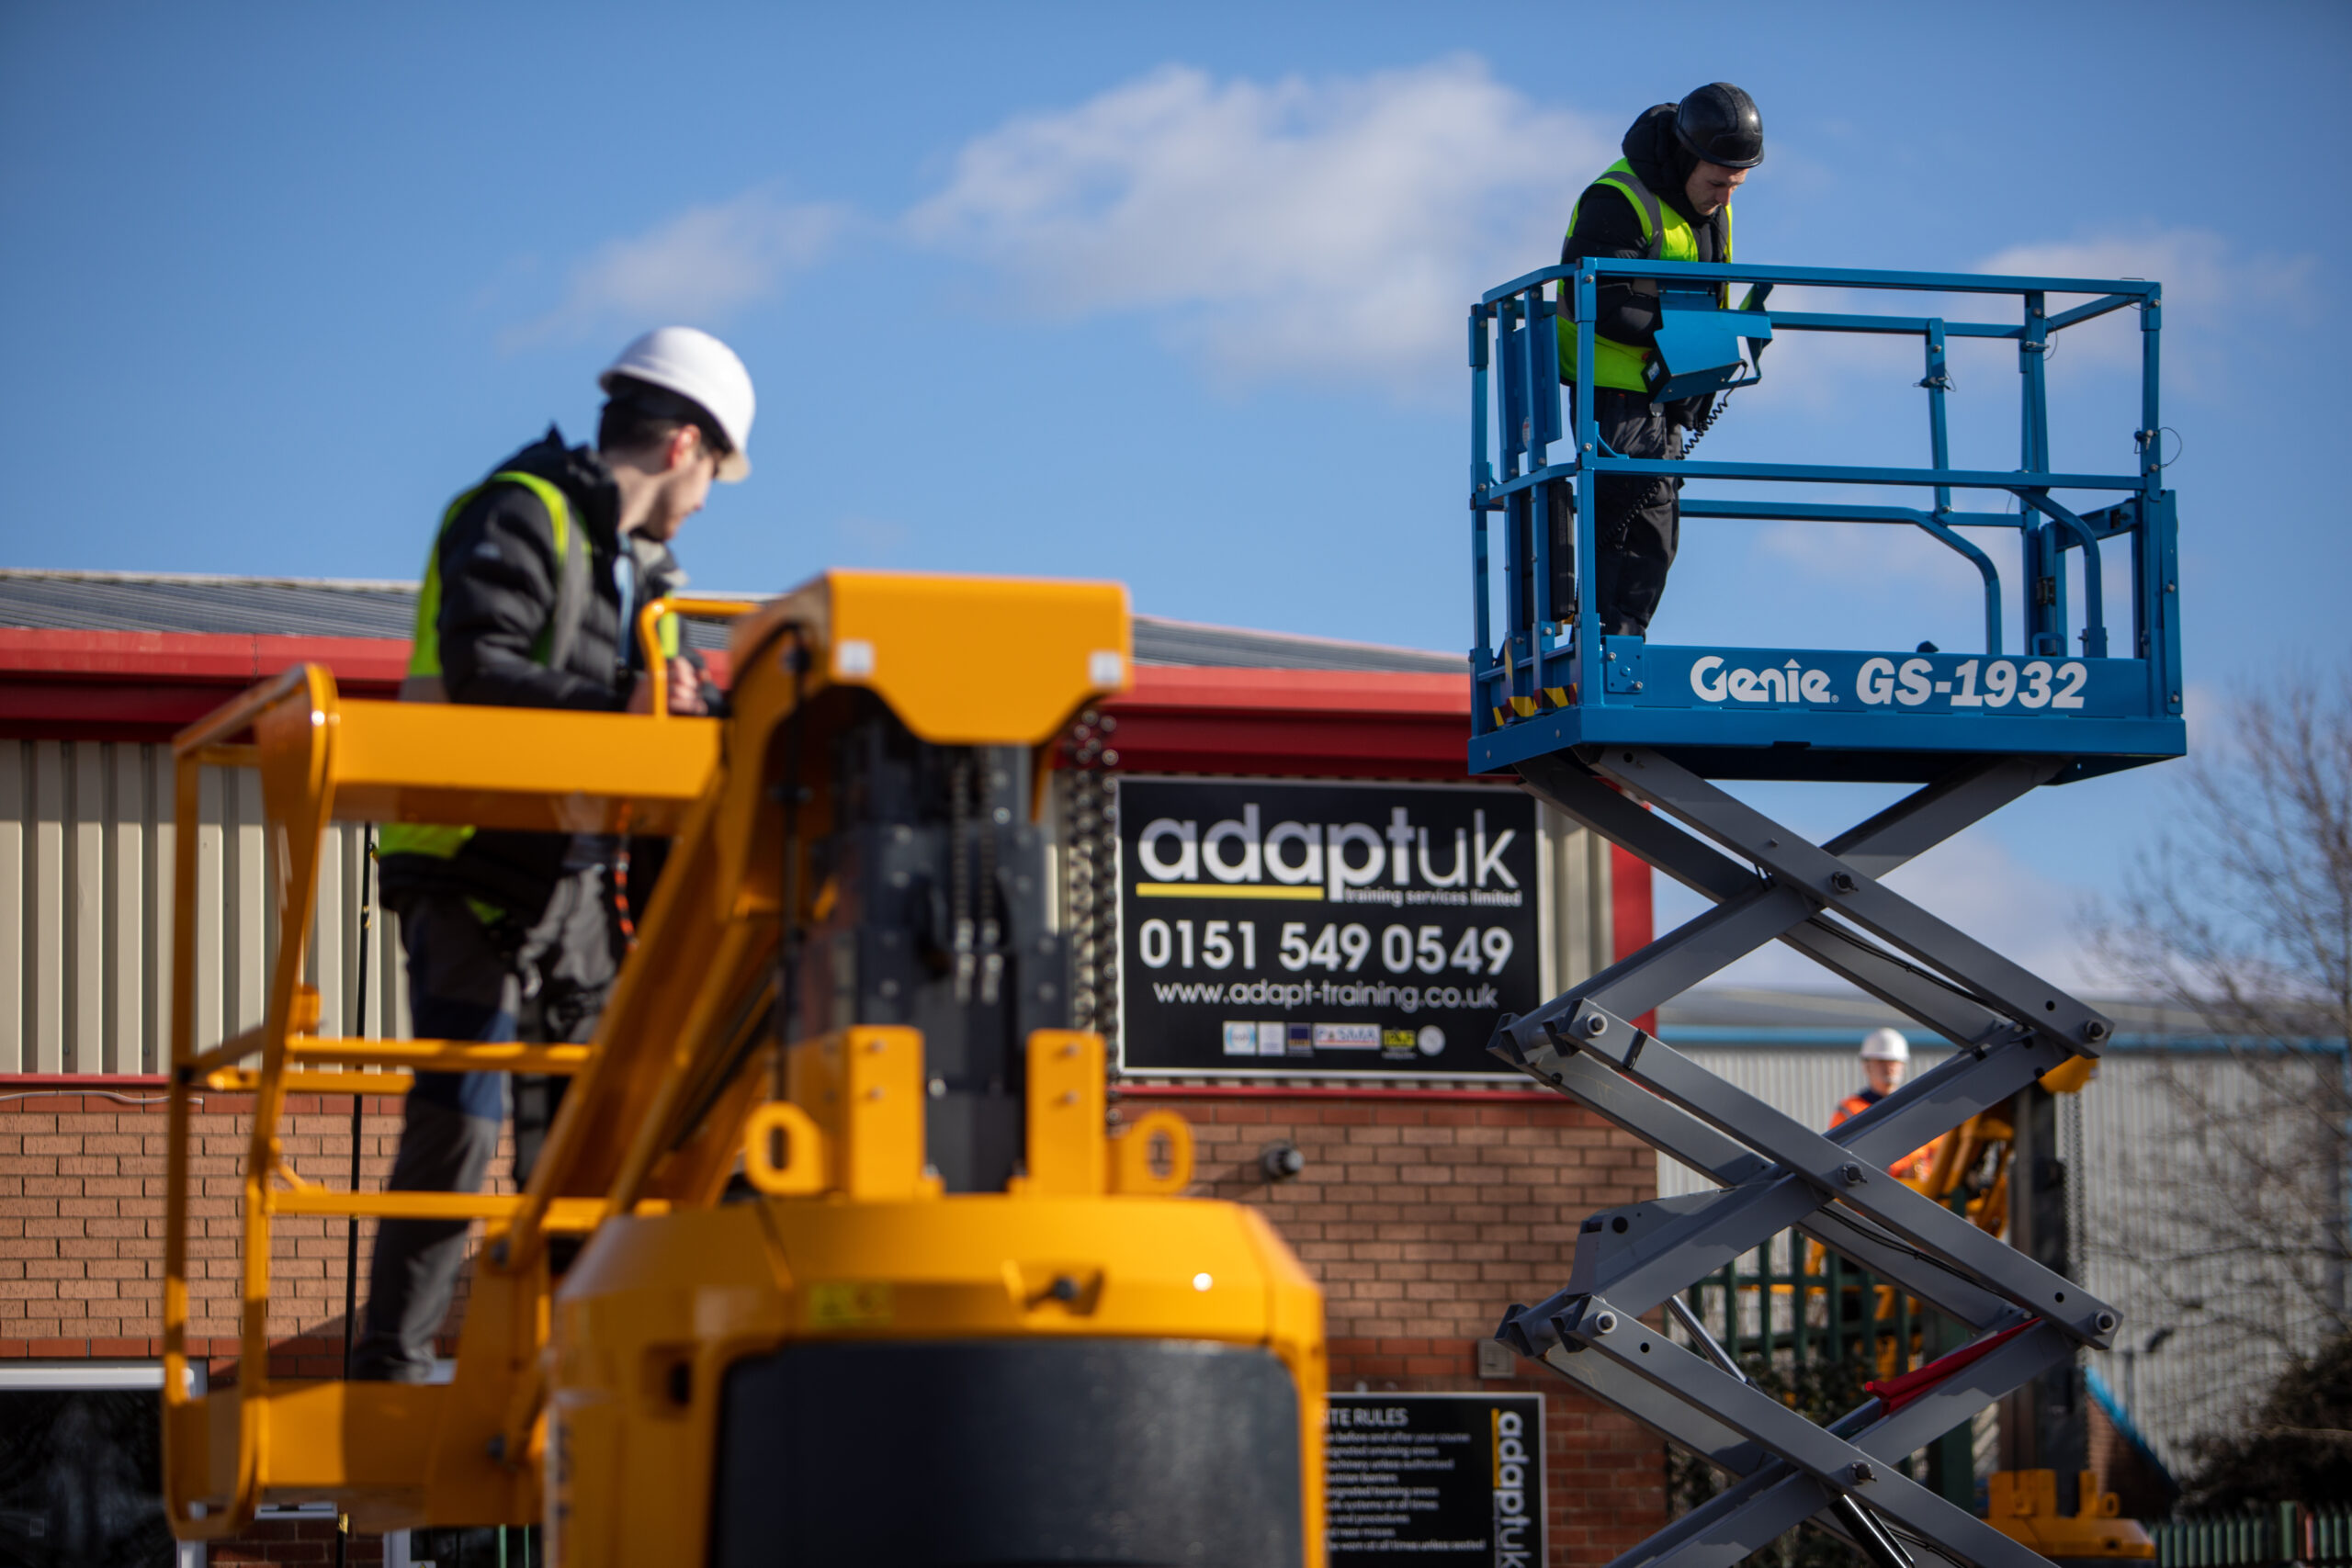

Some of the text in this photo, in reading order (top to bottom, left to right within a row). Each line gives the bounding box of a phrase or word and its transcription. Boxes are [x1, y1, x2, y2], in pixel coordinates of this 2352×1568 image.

[1690, 656, 2088, 709] Genie GS-1932
[1137, 803, 1521, 903] adaptuk
[1344, 886, 1522, 908] training services limited
[1139, 919, 1514, 976] 0151 549 0549
[1152, 979, 1498, 1013] www.adapt-training.co.uk
[1352, 1407, 1409, 1427] RULES
